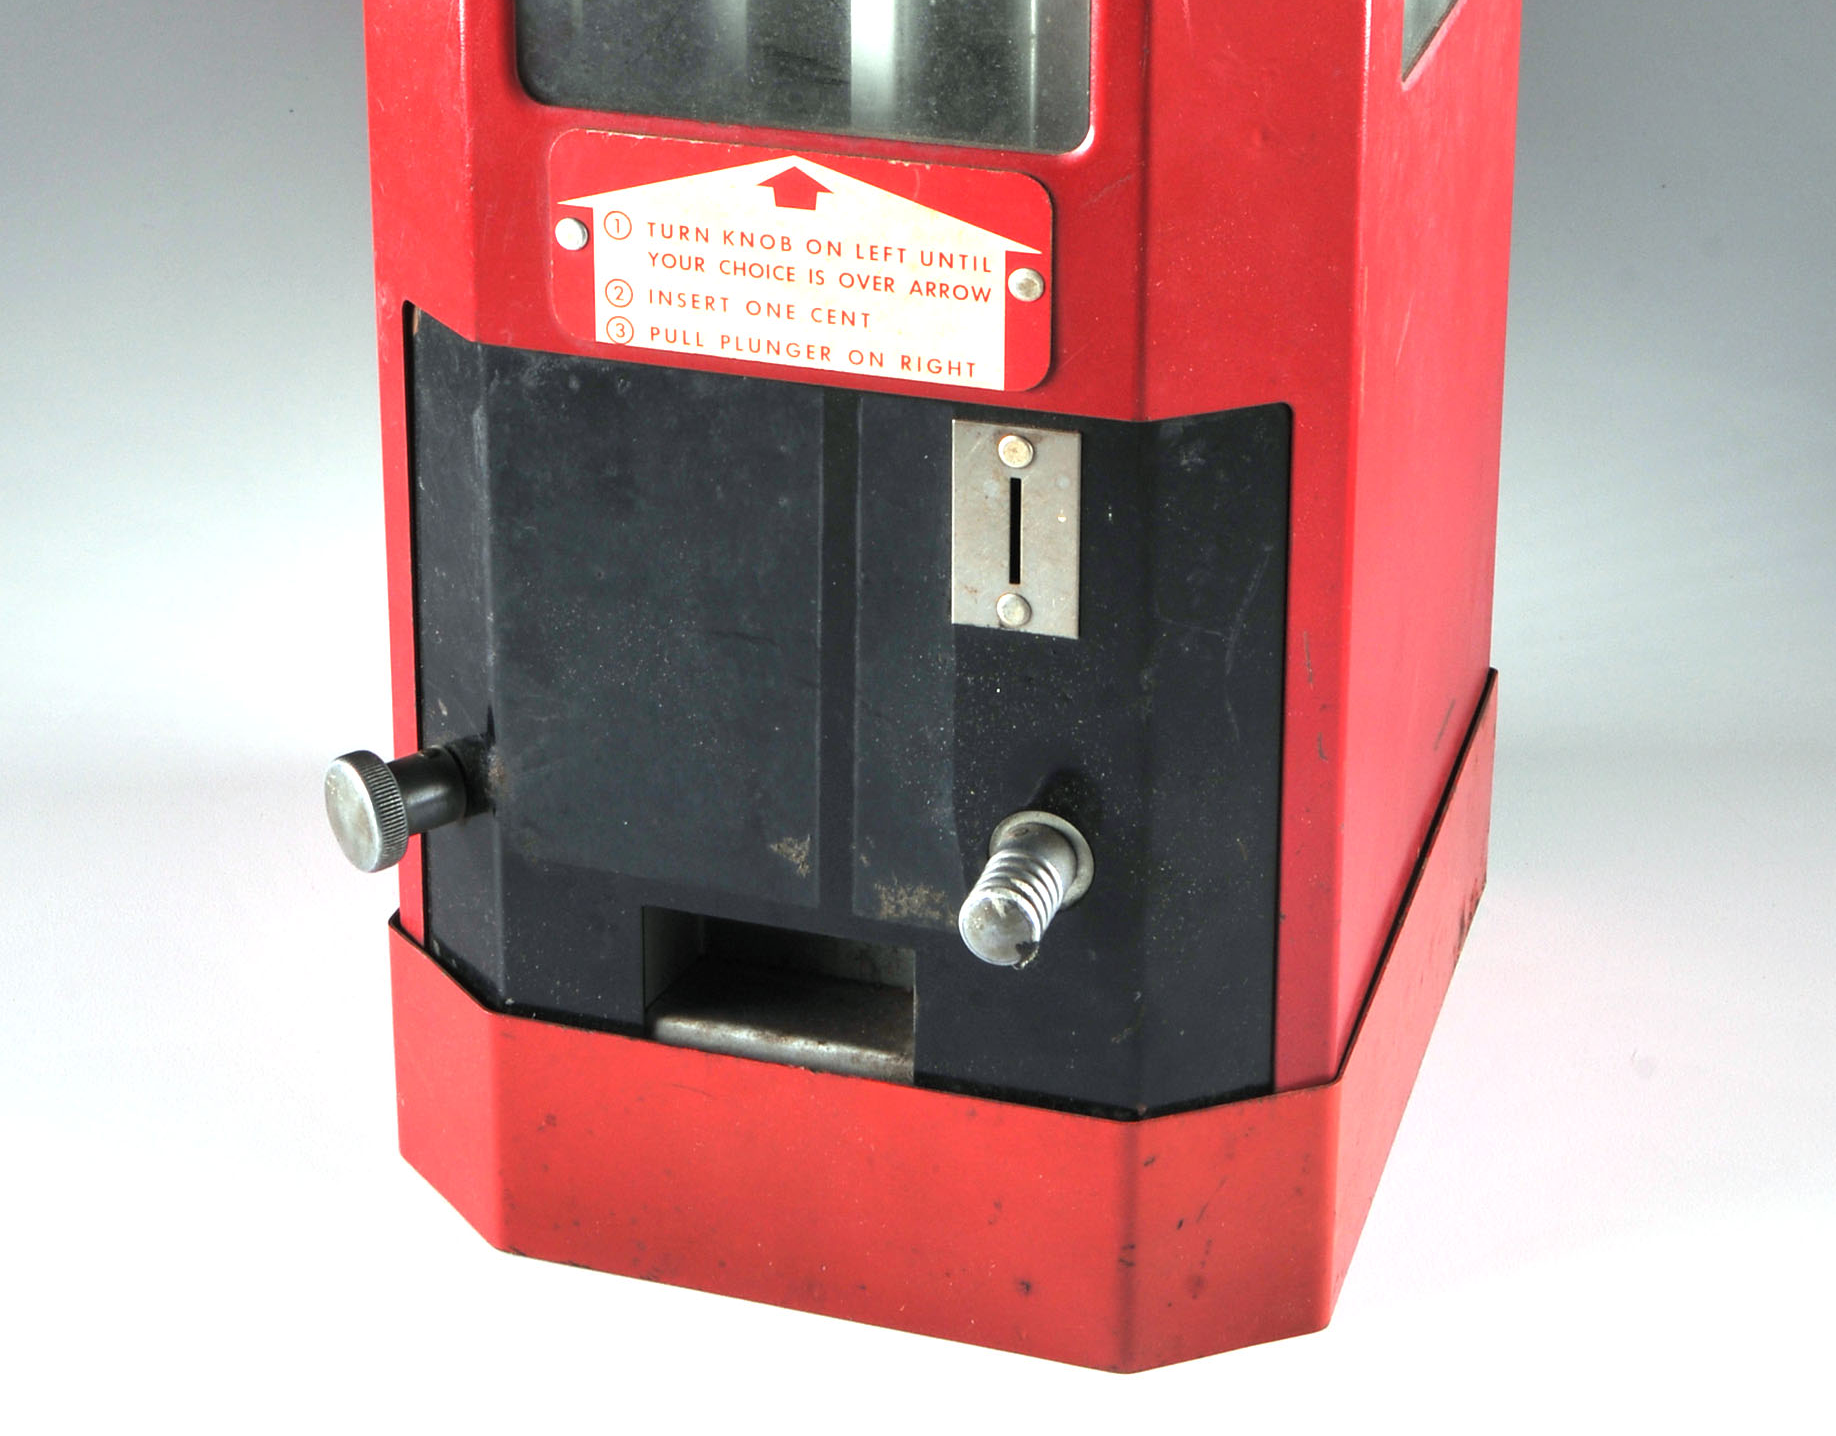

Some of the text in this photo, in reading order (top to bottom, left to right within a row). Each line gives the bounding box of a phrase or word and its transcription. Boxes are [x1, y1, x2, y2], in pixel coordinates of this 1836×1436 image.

[647, 221, 710, 244] TURN
[723, 229, 792, 253] KNOB
[805, 238, 843, 258] ON
[855, 243, 907, 265] LEFT
[920, 249, 993, 274] UNTIL
[647, 251, 993, 304] YOUR CHOICE IS OVER ARROW
[649, 288, 730, 314] INSERT
[746, 300, 796, 321] ONE
[811, 306, 872, 330] CENT
[650, 326, 705, 348] PULL
[720, 334, 832, 363] PLUNGER
[848, 348, 885, 368] ON
[900, 354, 976, 379] RIGHT
